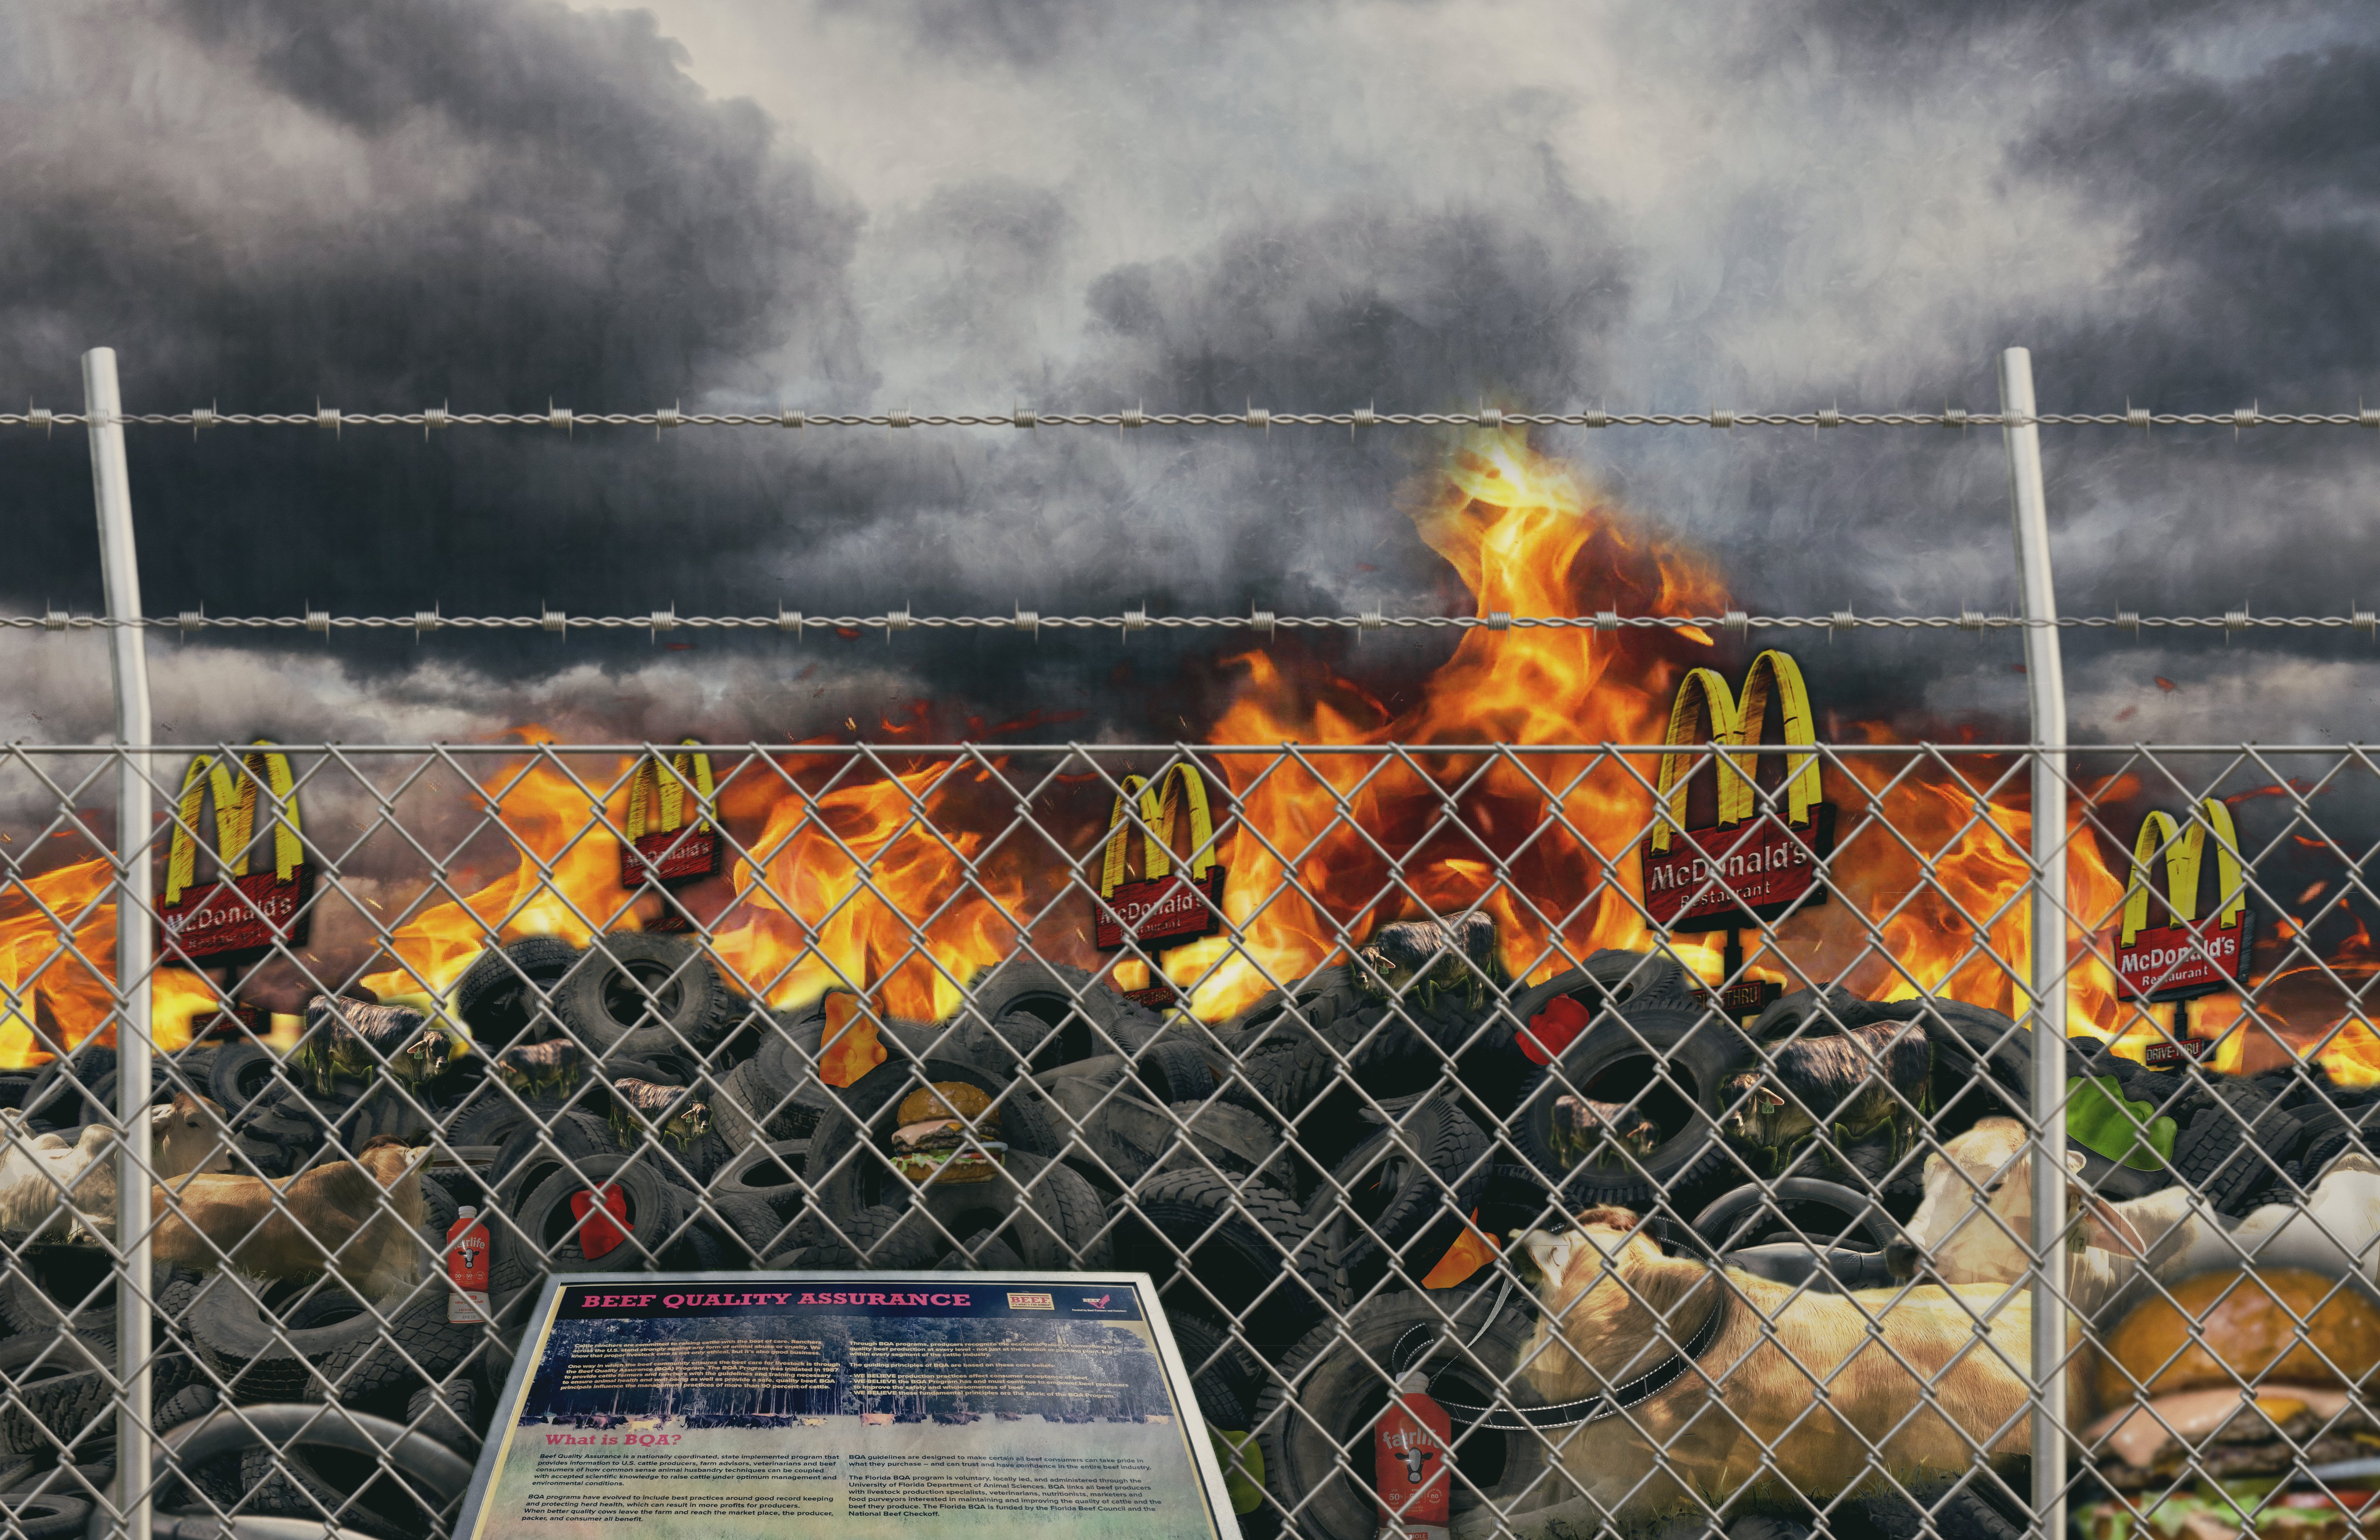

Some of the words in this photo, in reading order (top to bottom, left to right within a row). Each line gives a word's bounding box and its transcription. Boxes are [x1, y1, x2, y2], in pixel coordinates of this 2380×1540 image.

[1652, 841, 1808, 892] McDnald's
[1680, 881, 1771, 908] Rstarant
[1101, 892, 1203, 924] McDoald's
[1121, 918, 1181, 937] taurant
[2142, 965, 2208, 987] Resaurant
[1687, 987, 1757, 1009] RI-THRU
[581, 1295, 657, 1308] BEEF
[663, 1293, 792, 1309] QUALITY
[797, 1293, 971, 1306] ASSURANCE
[546, 1434, 596, 1445] What
[601, 1434, 618, 1445] is
[623, 1434, 682, 1447] BQA?
